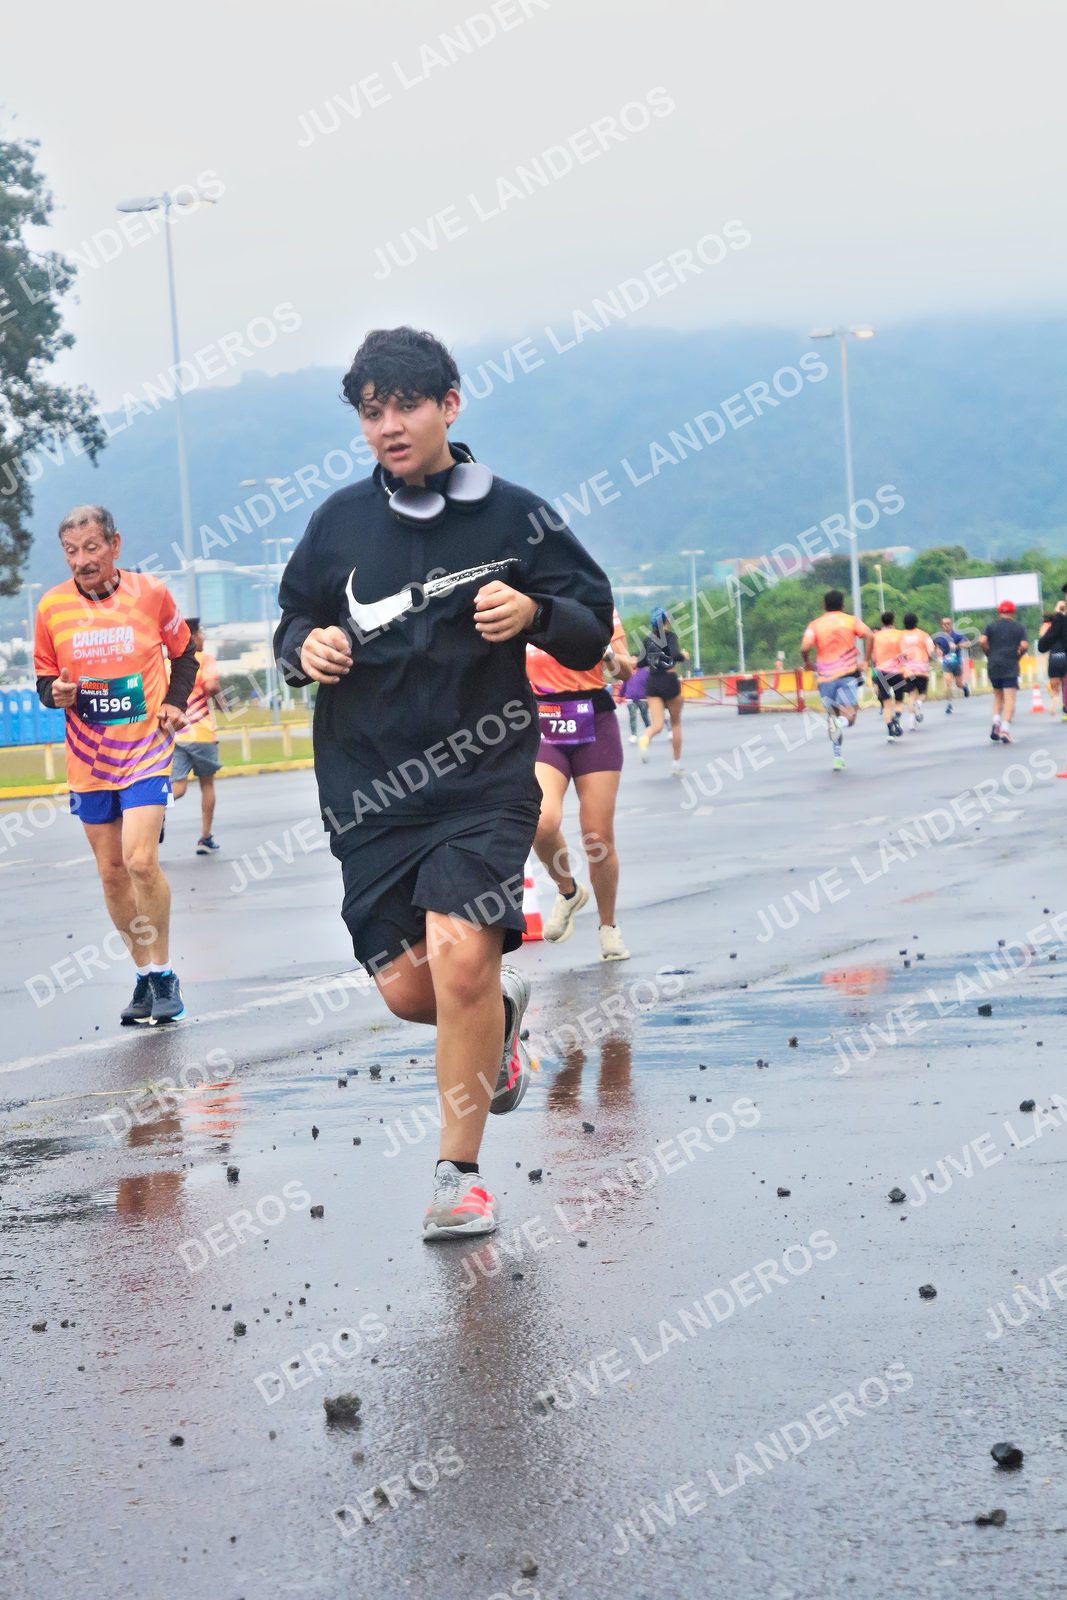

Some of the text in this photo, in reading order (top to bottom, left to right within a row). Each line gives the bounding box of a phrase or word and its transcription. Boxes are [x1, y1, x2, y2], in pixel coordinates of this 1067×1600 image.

[73, 626, 134, 649] CARRERA
[73, 645, 122, 660] OMNILIFE
[89, 696, 132, 713] 1596
[549, 720, 577, 733] 728
